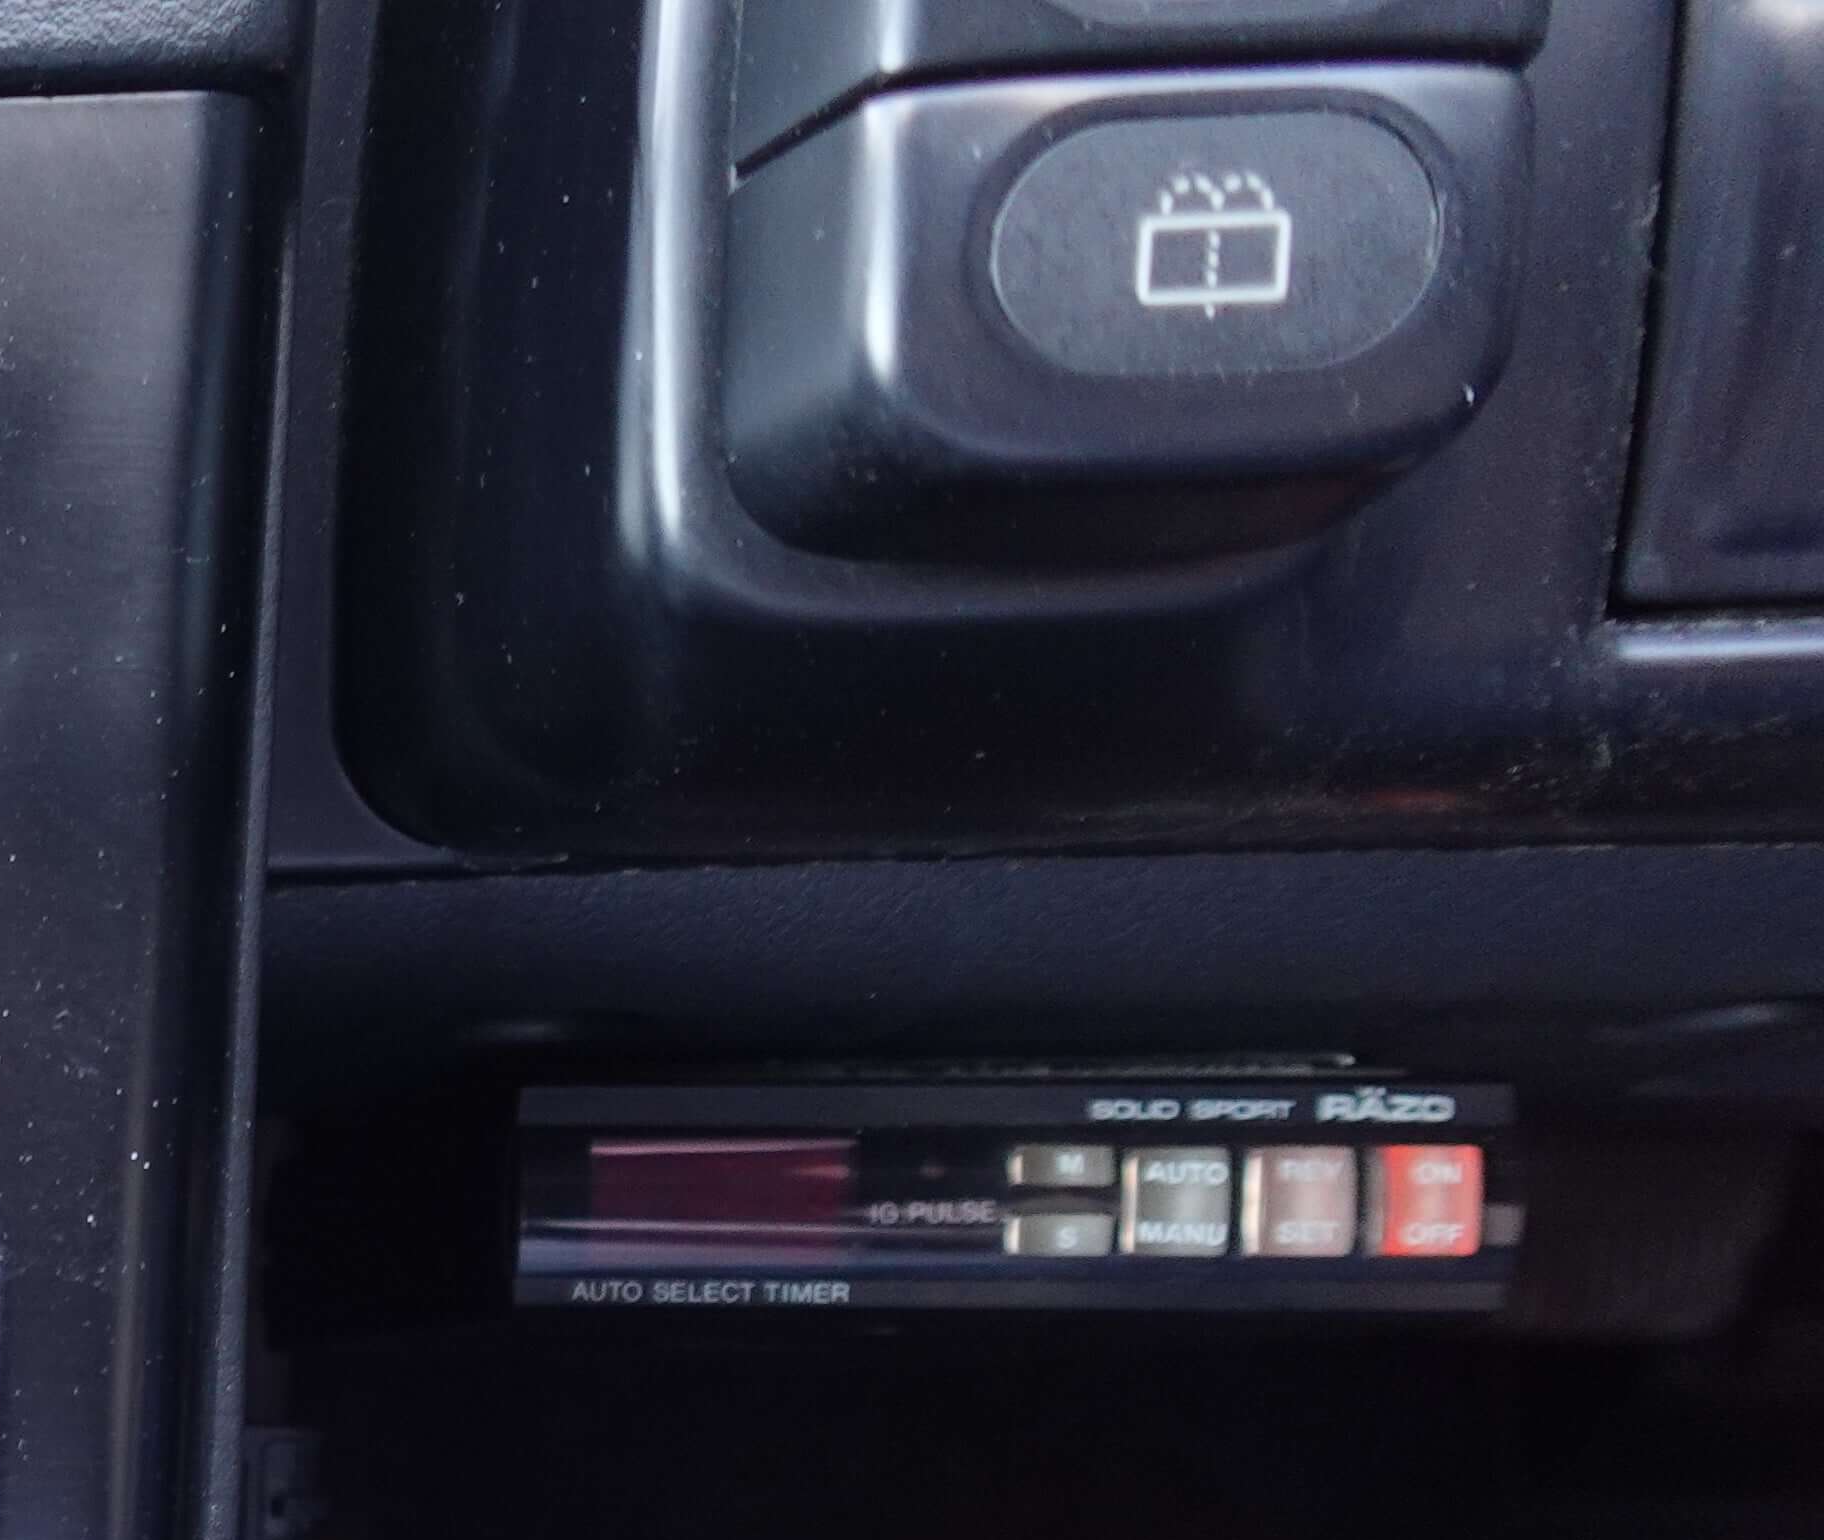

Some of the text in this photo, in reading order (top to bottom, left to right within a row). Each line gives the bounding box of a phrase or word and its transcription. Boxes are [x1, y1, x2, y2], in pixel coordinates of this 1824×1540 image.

[1088, 1100, 1181, 1120] SOLID
[1186, 1100, 1297, 1120] SPORT
[1059, 1153, 1084, 1175] M
[1145, 1160, 1229, 1185] AUTO
[1412, 1161, 1462, 1184] ON
[907, 1200, 997, 1224] PULSE
[1058, 1227, 1078, 1248] S
[1137, 1223, 1227, 1245] MANU
[1275, 1223, 1340, 1244] SET
[1401, 1223, 1464, 1245] OFF
[571, 1281, 851, 1304] AUTO SELECT TIMER
